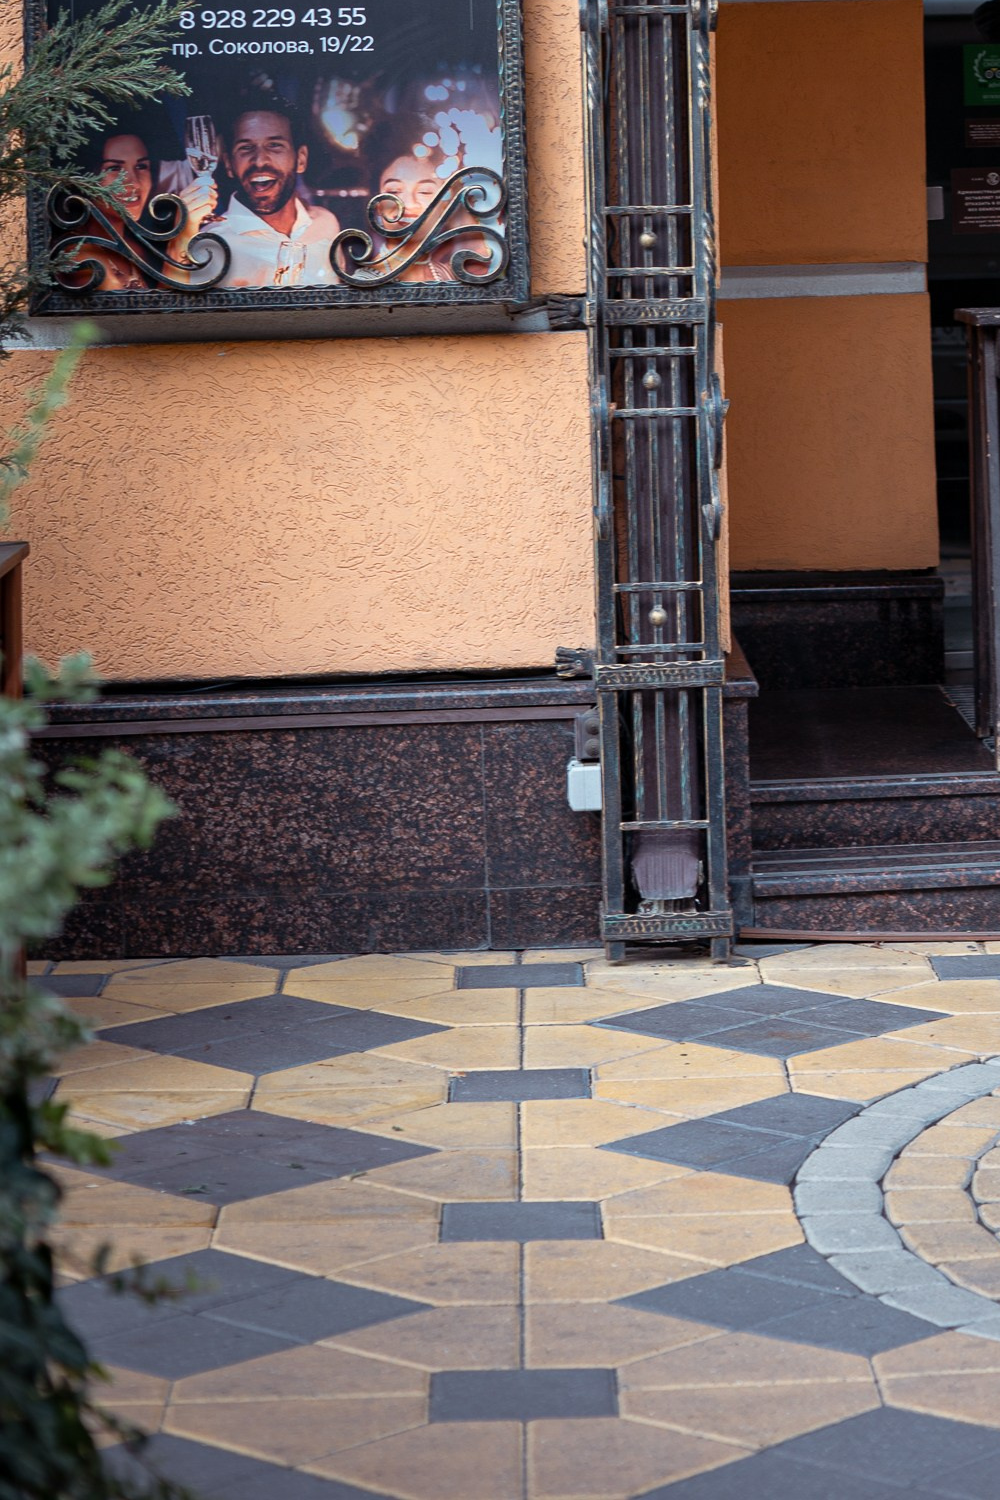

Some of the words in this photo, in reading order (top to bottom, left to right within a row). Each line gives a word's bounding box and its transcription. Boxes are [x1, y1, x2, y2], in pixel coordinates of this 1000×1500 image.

[179, 10, 196, 29] 8
[201, 10, 247, 29] 928
[252, 9, 296, 28] 229
[301, 7, 332, 27] 43
[337, 7, 367, 26] 55
[172, 42, 203, 58] пр.
[208, 38, 314, 55] Соколова,
[319, 35, 375, 54] 19/22
